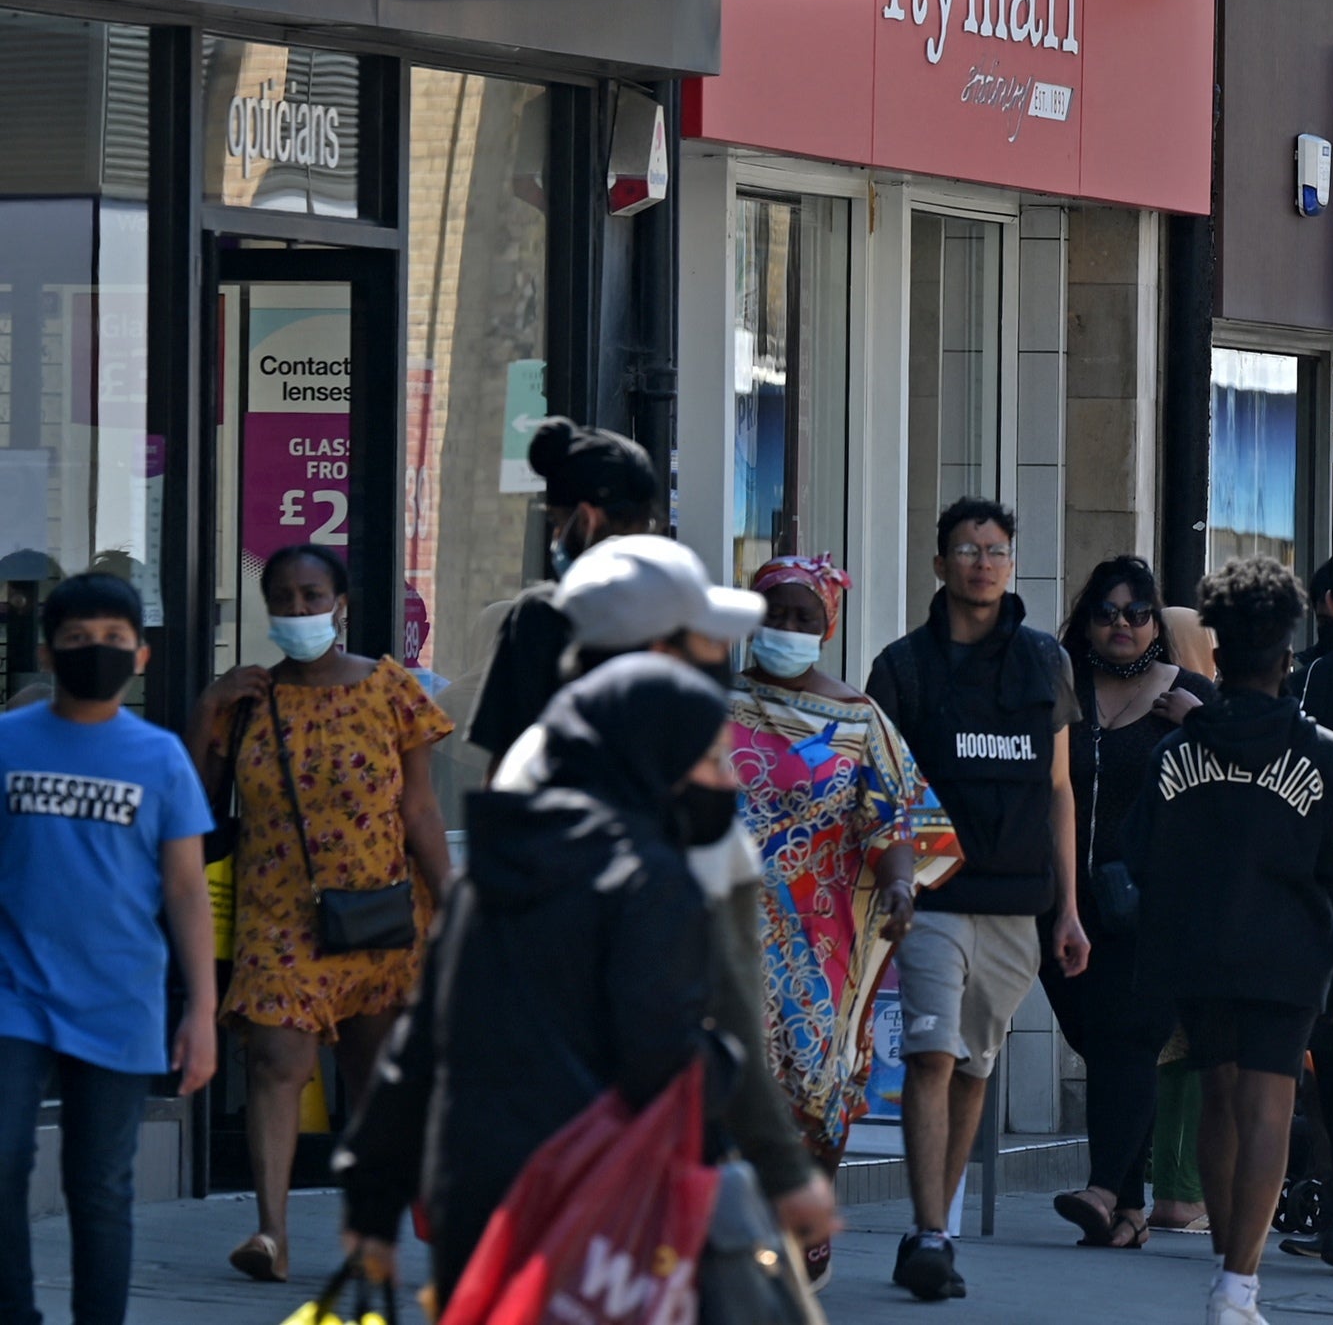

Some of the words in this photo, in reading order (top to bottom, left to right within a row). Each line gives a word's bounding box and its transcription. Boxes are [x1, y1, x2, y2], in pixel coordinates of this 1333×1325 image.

[227, 80, 340, 179] opticians
[260, 355, 351, 376] Contact
[1257, 748, 1324, 817] AIR
